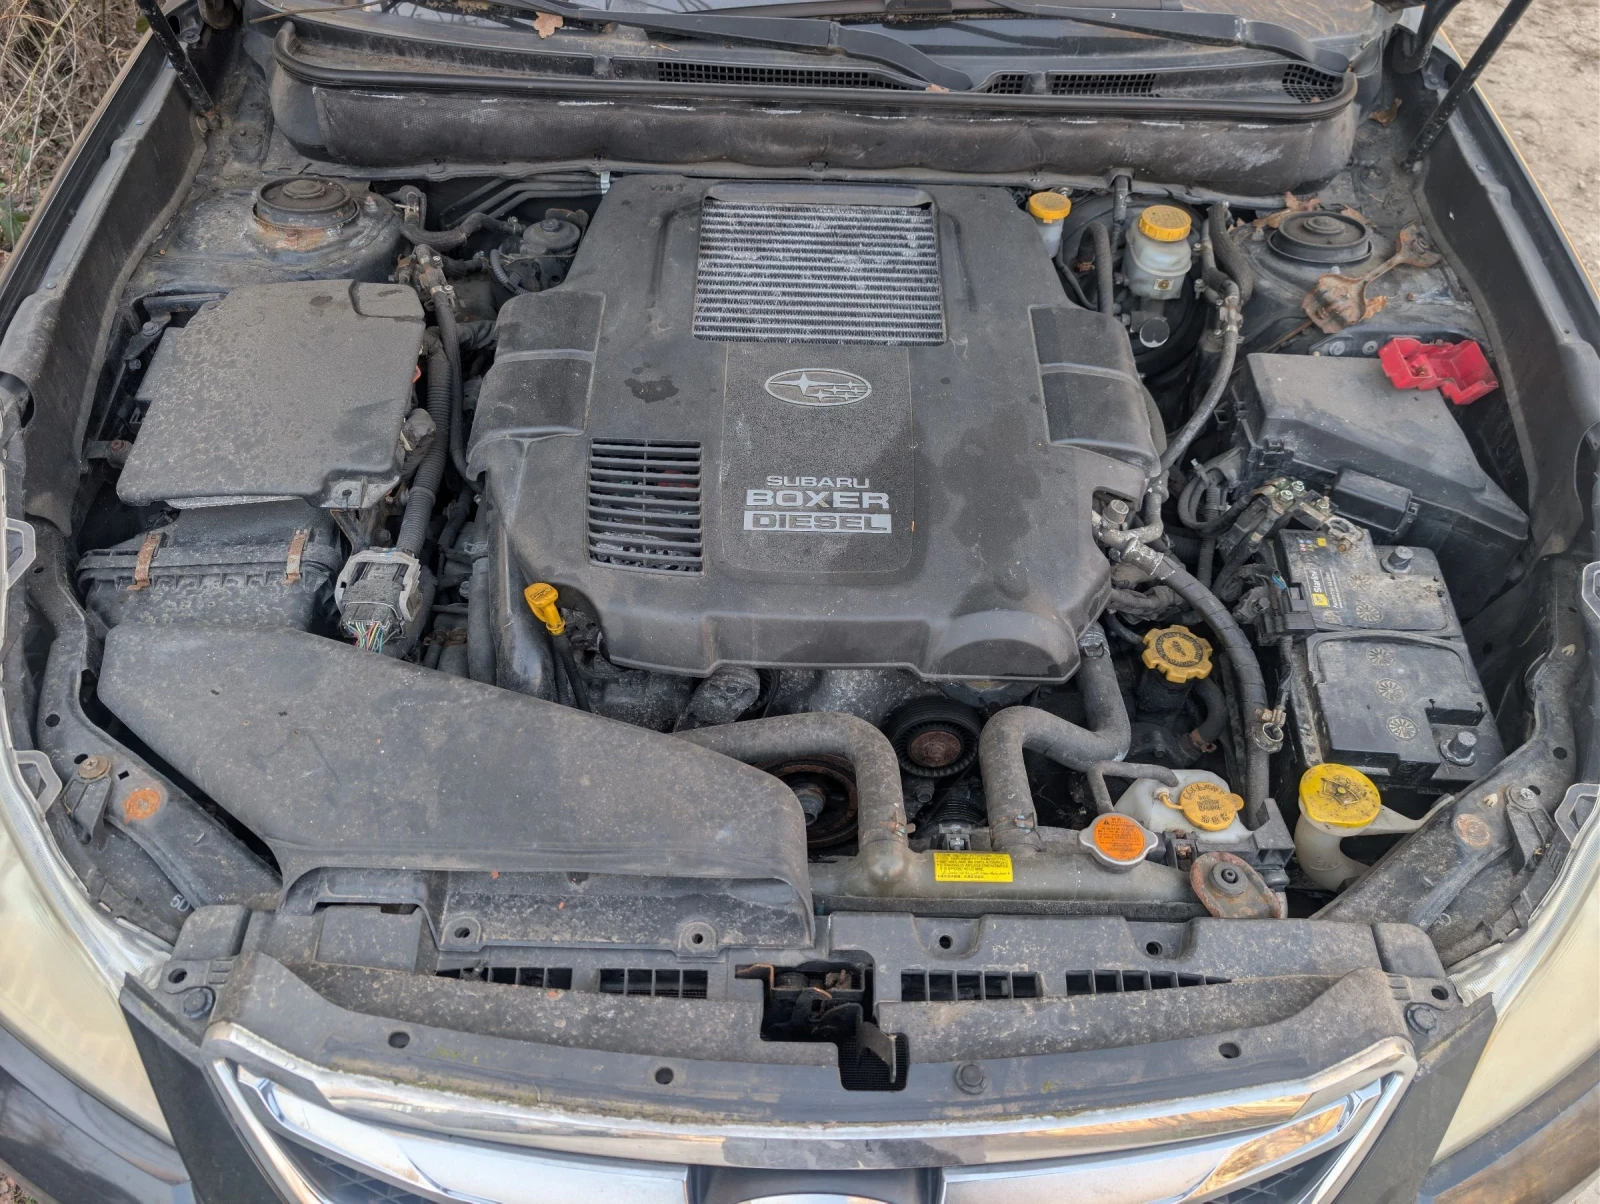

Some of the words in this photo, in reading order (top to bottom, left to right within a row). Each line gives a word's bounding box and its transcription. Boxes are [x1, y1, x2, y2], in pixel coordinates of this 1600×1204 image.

[766, 475, 870, 488] SUBARU
[746, 489, 890, 509] BOXER
[752, 513, 888, 531] DIESEL
